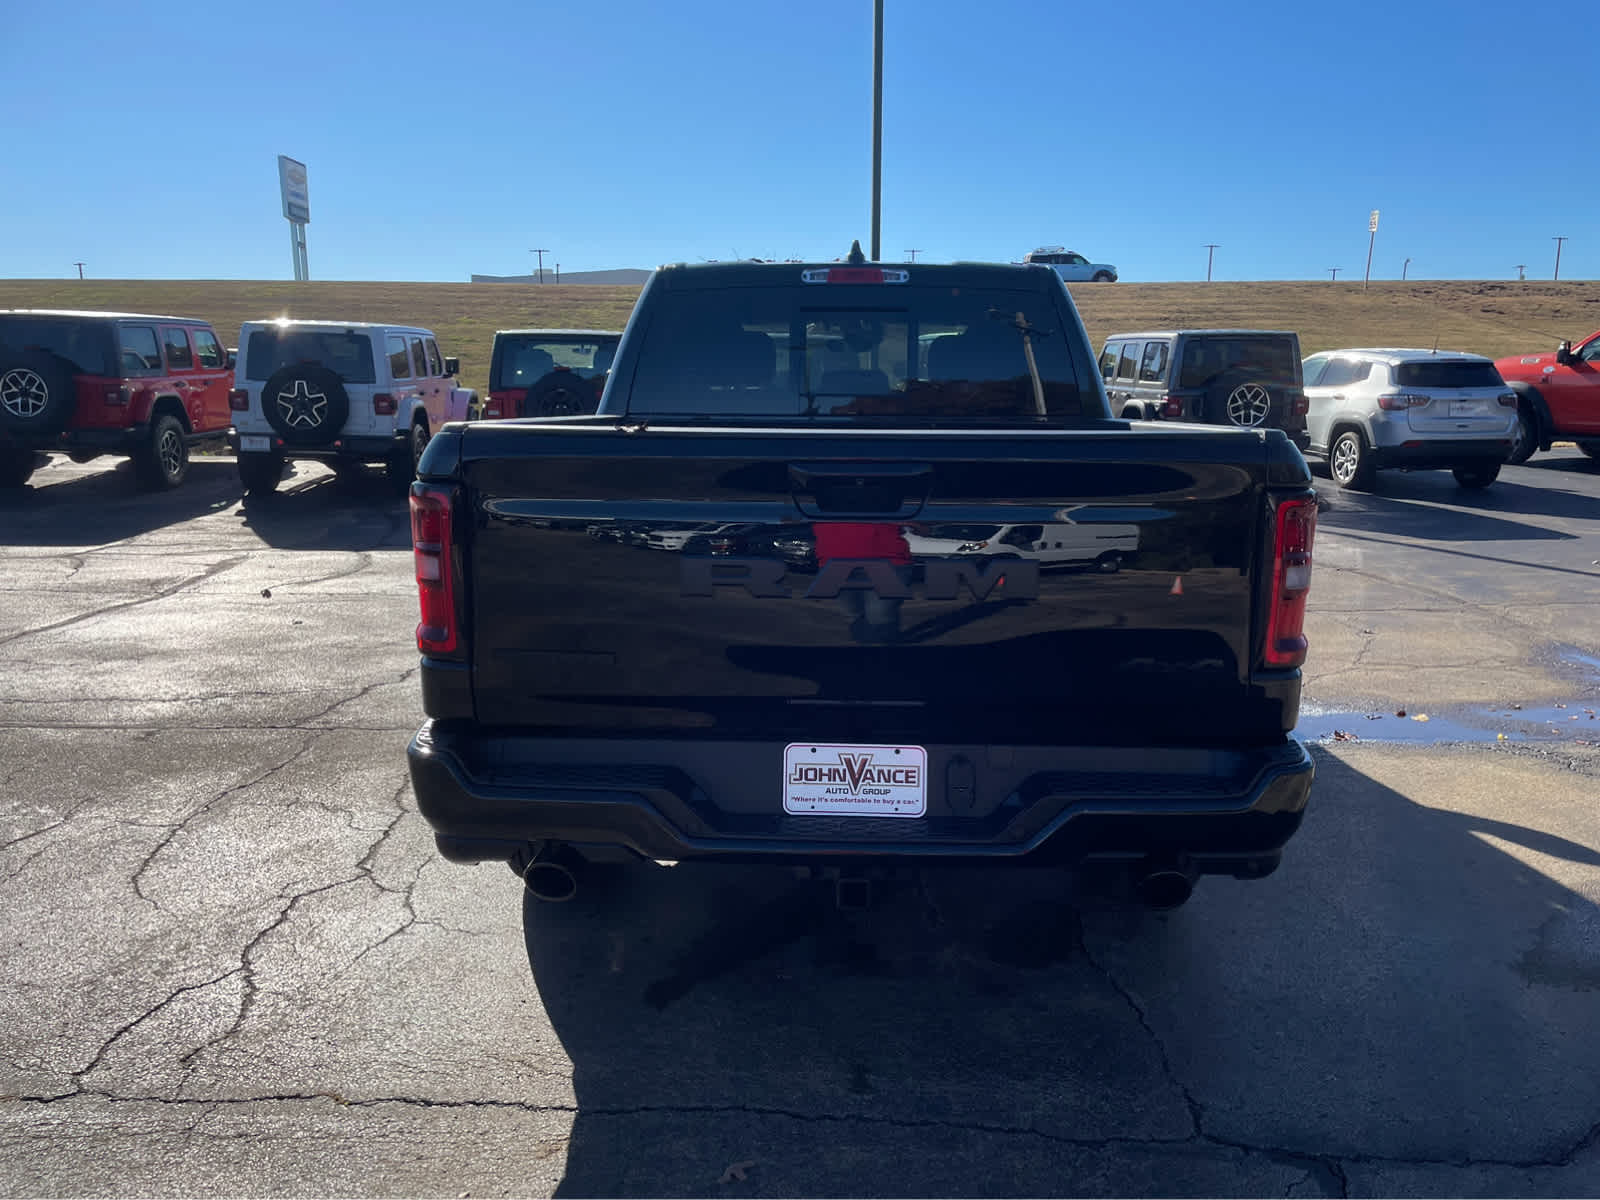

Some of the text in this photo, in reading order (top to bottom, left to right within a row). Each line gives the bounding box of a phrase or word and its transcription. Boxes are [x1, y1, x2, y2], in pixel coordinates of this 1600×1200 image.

[680, 557, 1041, 601] RAM
[793, 755, 917, 793] JOHN VANCE
[825, 787, 891, 796] AUTO GROUP
[882, 798, 896, 806] buy
